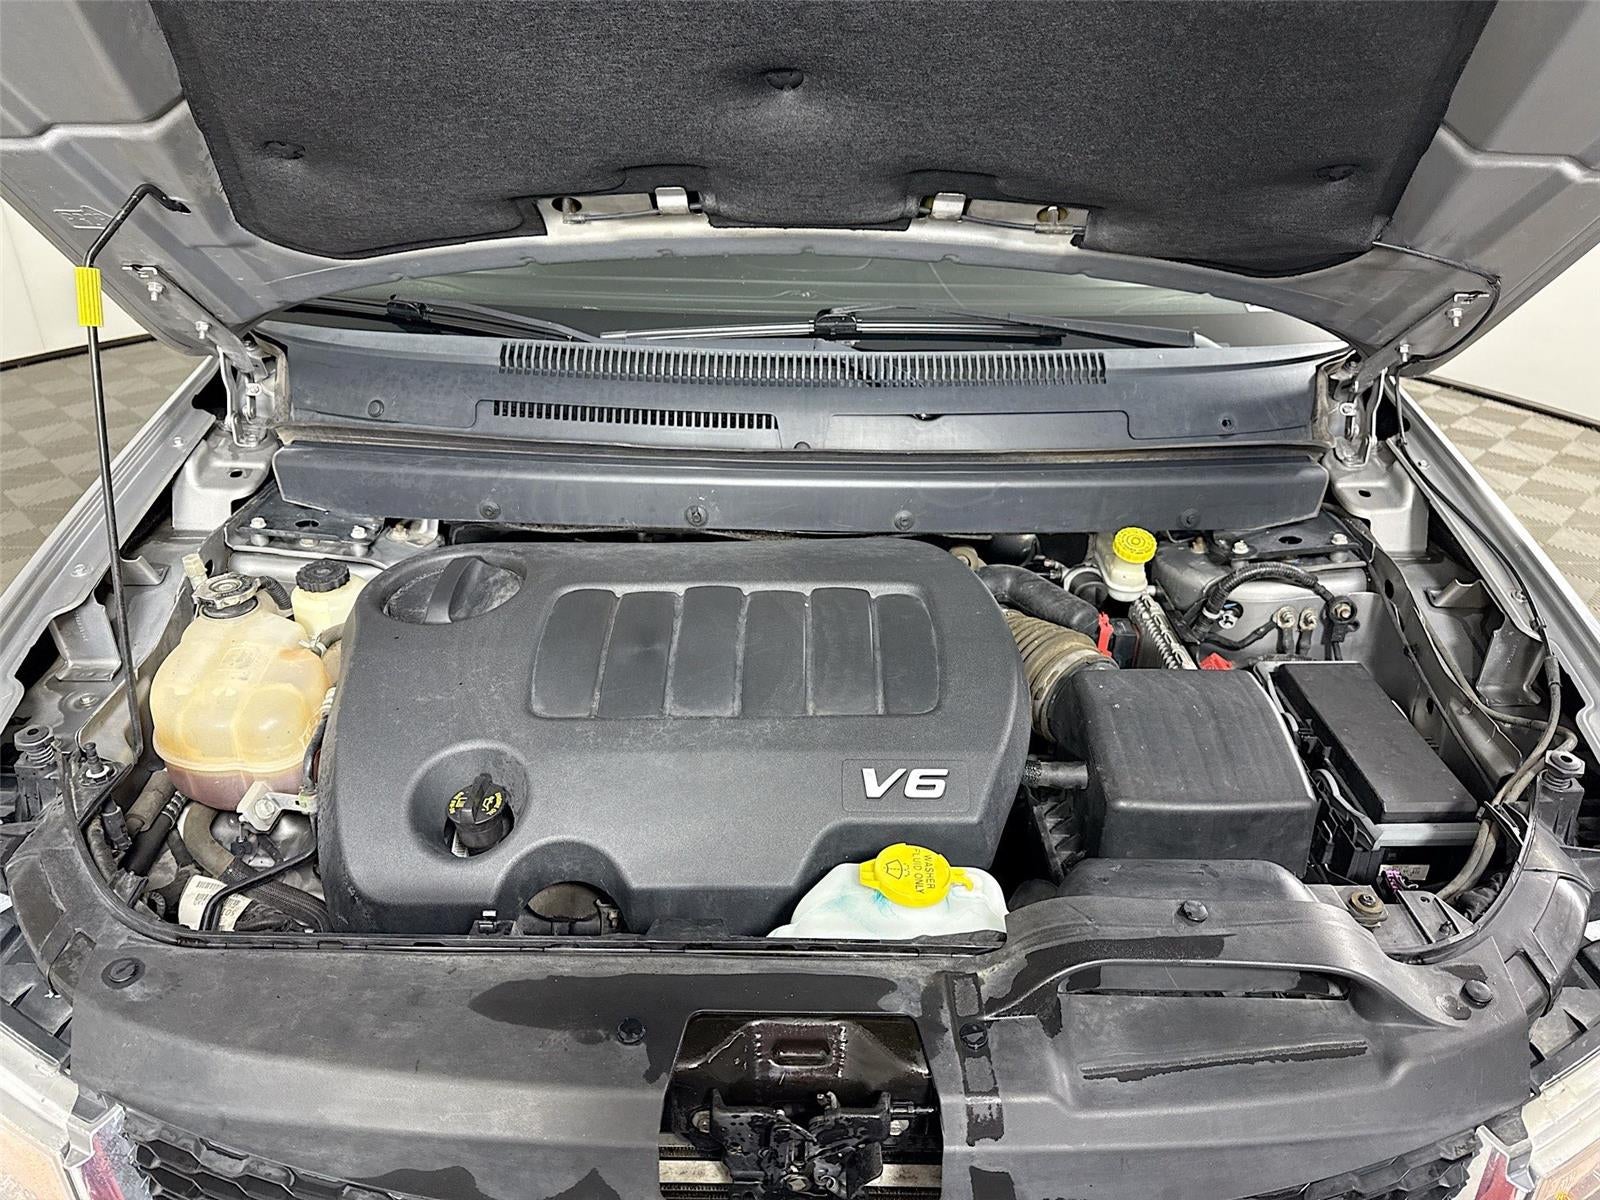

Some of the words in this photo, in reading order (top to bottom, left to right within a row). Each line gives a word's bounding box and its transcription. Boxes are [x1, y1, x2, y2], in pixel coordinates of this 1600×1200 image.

[862, 768, 949, 799] V6
[912, 848, 923, 871] FLUID
[924, 854, 936, 889] WASHER
[914, 872, 925, 894] ONLY
